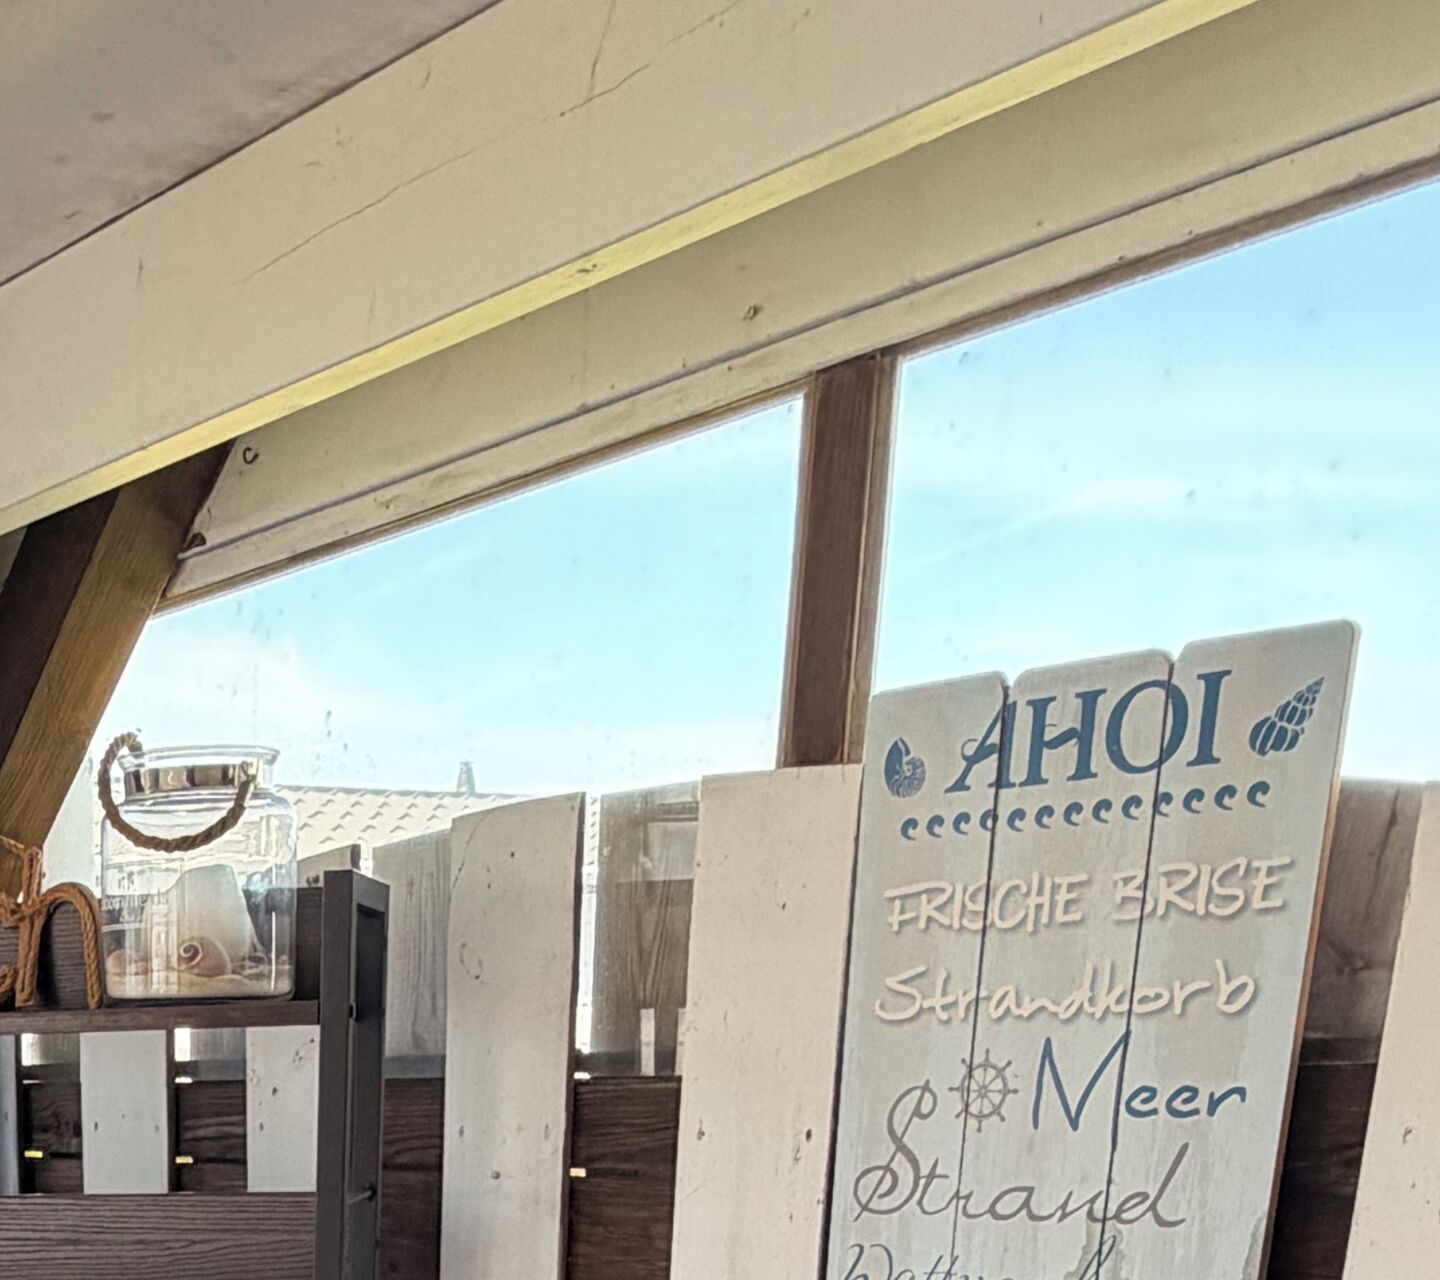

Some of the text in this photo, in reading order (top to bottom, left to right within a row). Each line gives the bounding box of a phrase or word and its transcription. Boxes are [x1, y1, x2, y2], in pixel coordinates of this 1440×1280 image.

[944, 669, 1232, 795] AHOI
[884, 856, 1294, 934] FRISCHE BRISE
[874, 959, 1256, 1024] Strandkorb
[1031, 1030, 1247, 1132] Meer
[853, 1078, 1189, 1228] Strand
